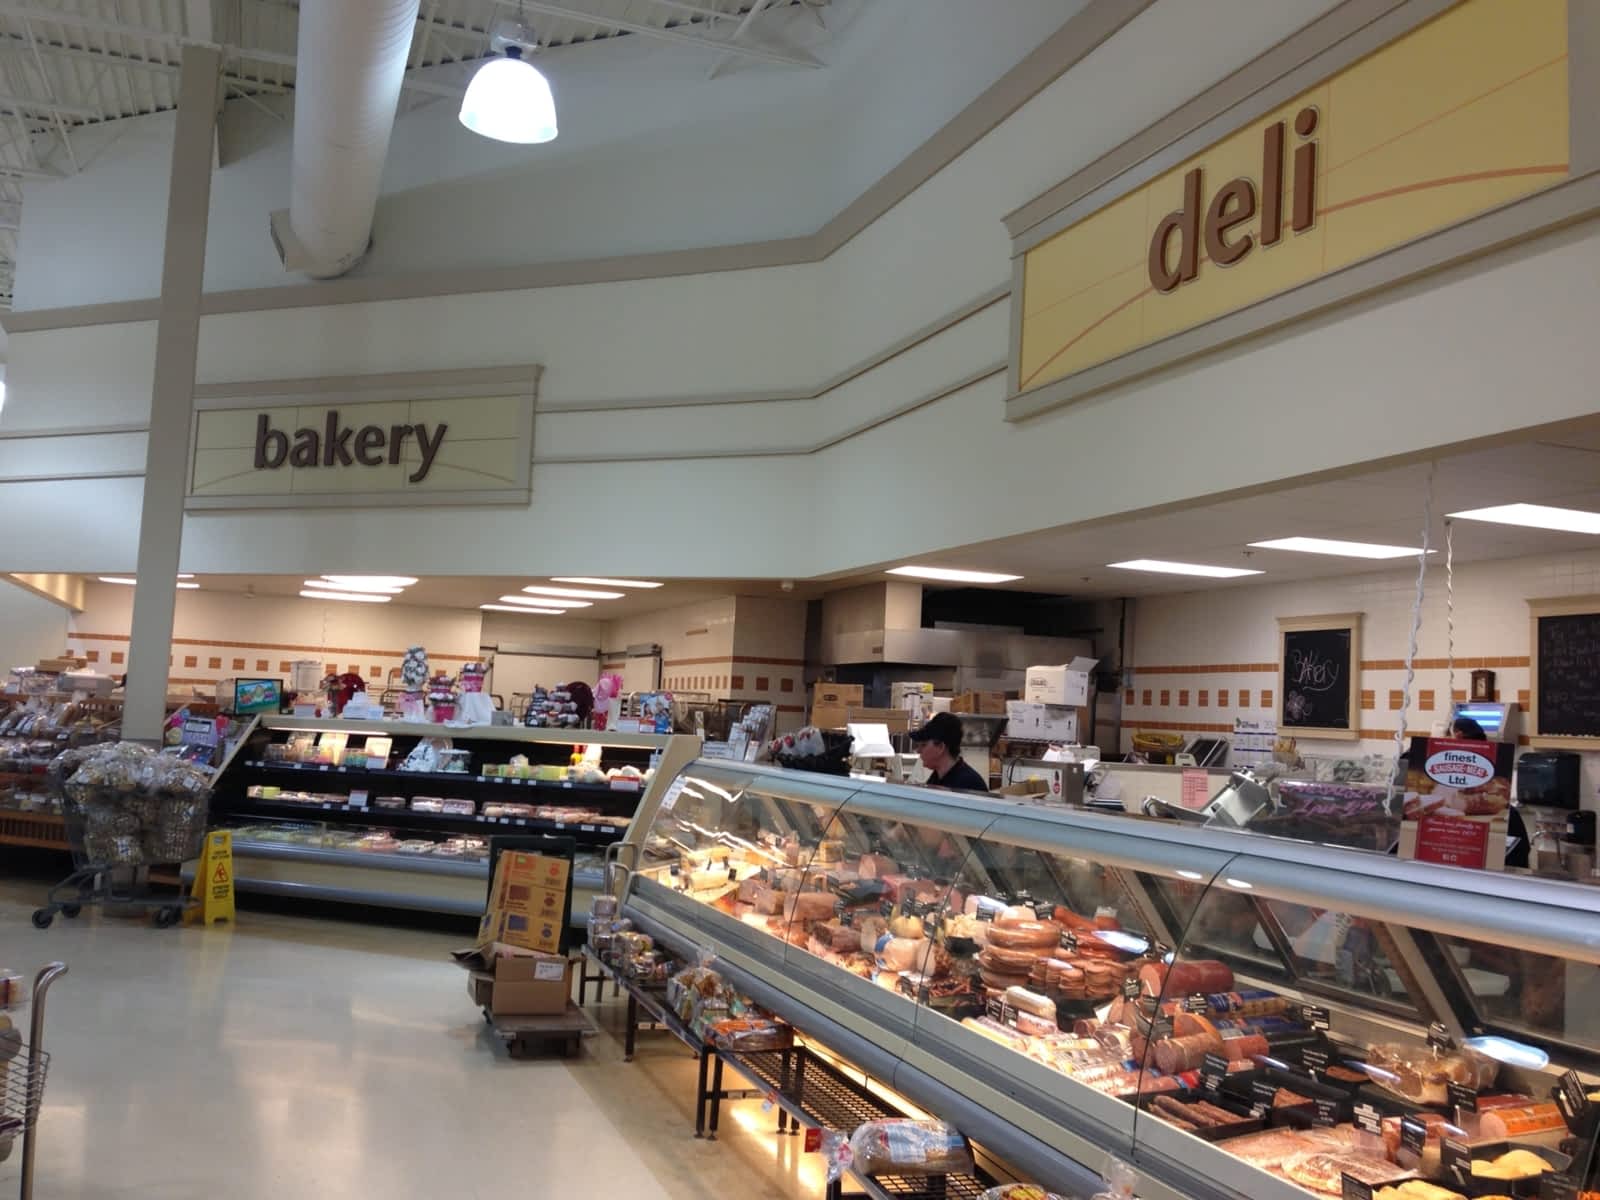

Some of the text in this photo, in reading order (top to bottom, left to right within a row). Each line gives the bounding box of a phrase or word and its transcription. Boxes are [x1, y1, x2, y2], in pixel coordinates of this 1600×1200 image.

[1148, 104, 1320, 295] deli
[253, 410, 448, 484] bakery
[1444, 752, 1477, 763] finest
